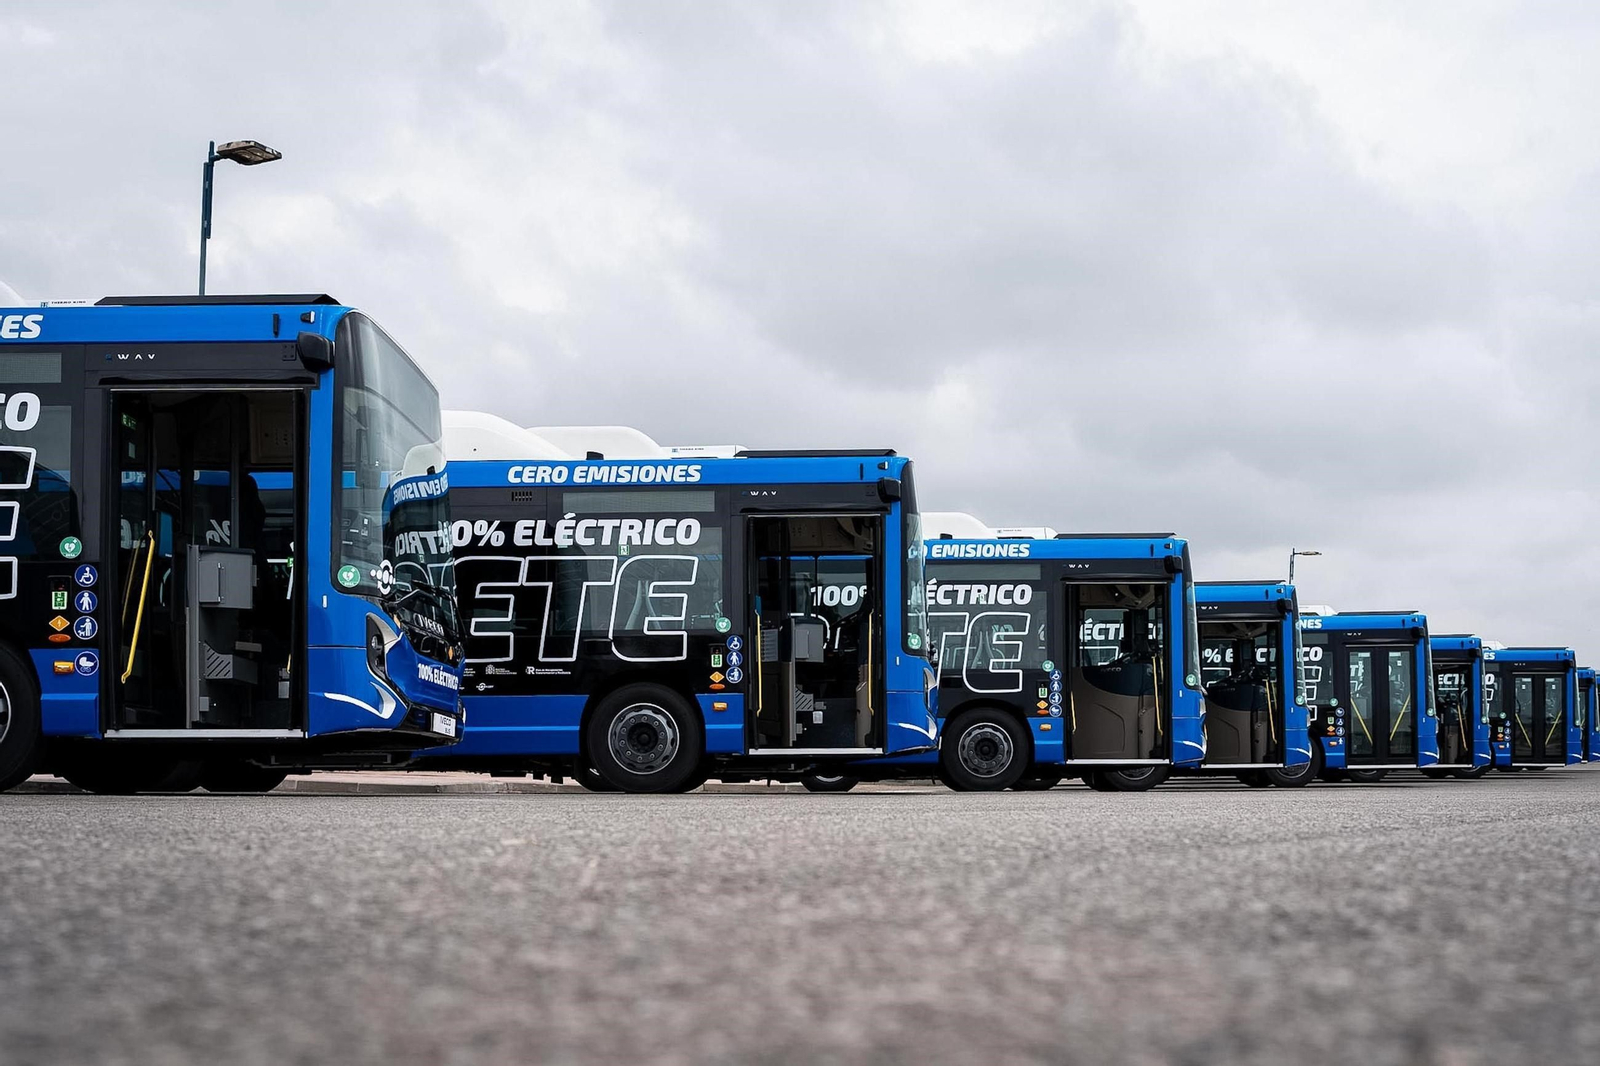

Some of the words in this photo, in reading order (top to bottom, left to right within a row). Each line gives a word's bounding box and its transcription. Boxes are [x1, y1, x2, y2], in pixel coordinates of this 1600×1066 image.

[0, 314, 43, 339] ES
[0, 392, 41, 431] O
[507, 465, 569, 483] CERO
[572, 465, 702, 483] EMISIONES
[513, 512, 701, 546] ELÉCTRICO
[931, 543, 1030, 558] EMISIONES
[417, 663, 434, 683] 100%
[433, 665, 459, 691] ELÉCTRICO
